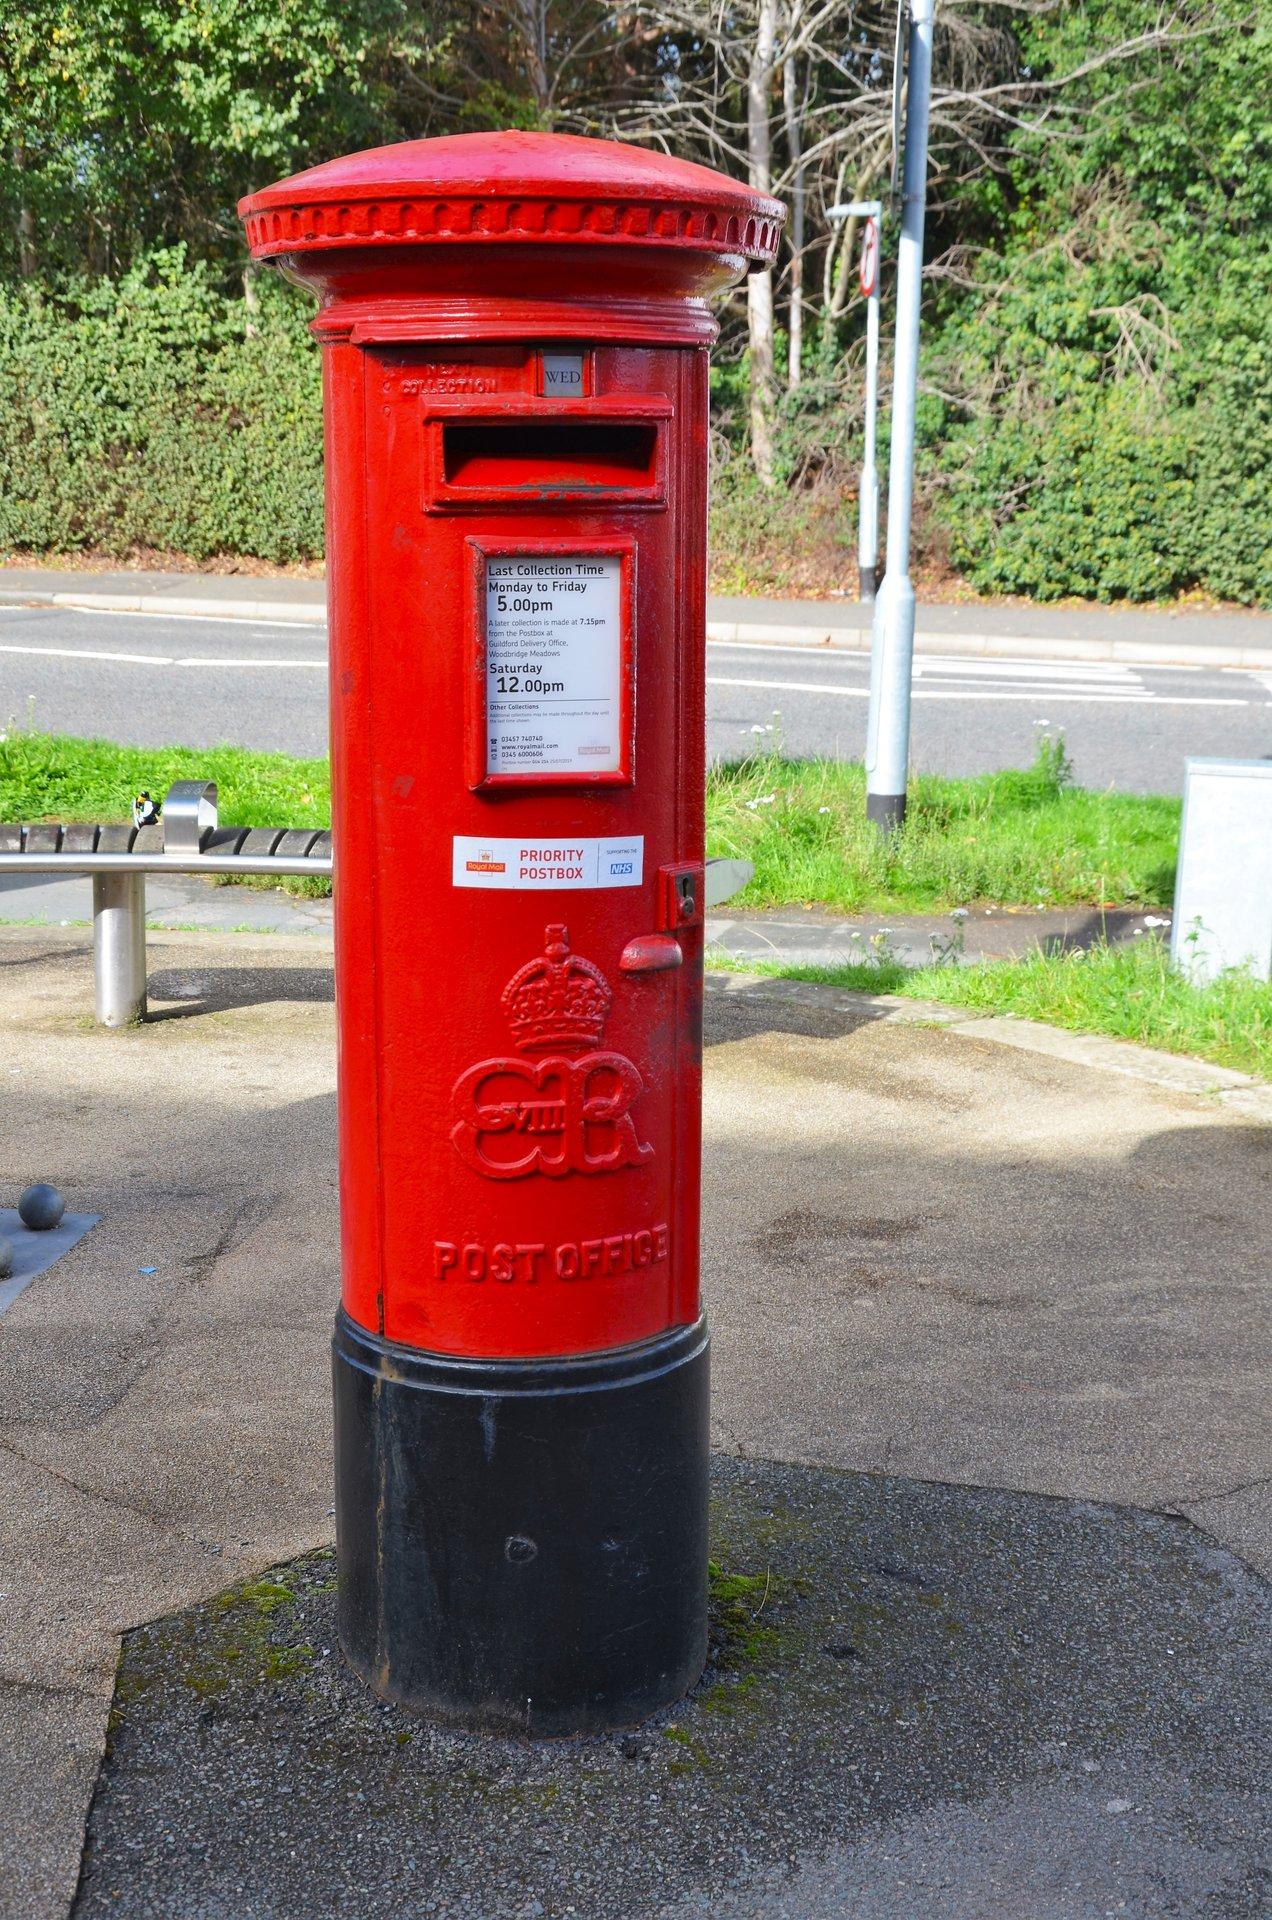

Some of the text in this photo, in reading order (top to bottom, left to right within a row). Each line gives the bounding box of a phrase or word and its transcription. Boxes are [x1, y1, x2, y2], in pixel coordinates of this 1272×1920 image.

[546, 371, 580, 384] WED
[401, 379, 496, 393] COLLECTION
[488, 564, 604, 576] Last Collection Time
[489, 581, 587, 594] Monday to Friday
[497, 595, 553, 614] 5.00pm
[511, 619, 542, 627] collection
[579, 618, 606, 627] 7.15pm
[489, 640, 518, 648] Guildford
[520, 640, 547, 648] Delivery
[489, 650, 528, 658] Woodbridge
[489, 664, 542, 675] Saturday
[497, 677, 564, 694] 12.00pm
[520, 850, 584, 862] PRIORITY
[467, 862, 505, 871] Royal Mail
[610, 863, 632, 874] NHS
[520, 868, 583, 879] POSTBOX
[433, 1222, 668, 1282] POST OFFICE
